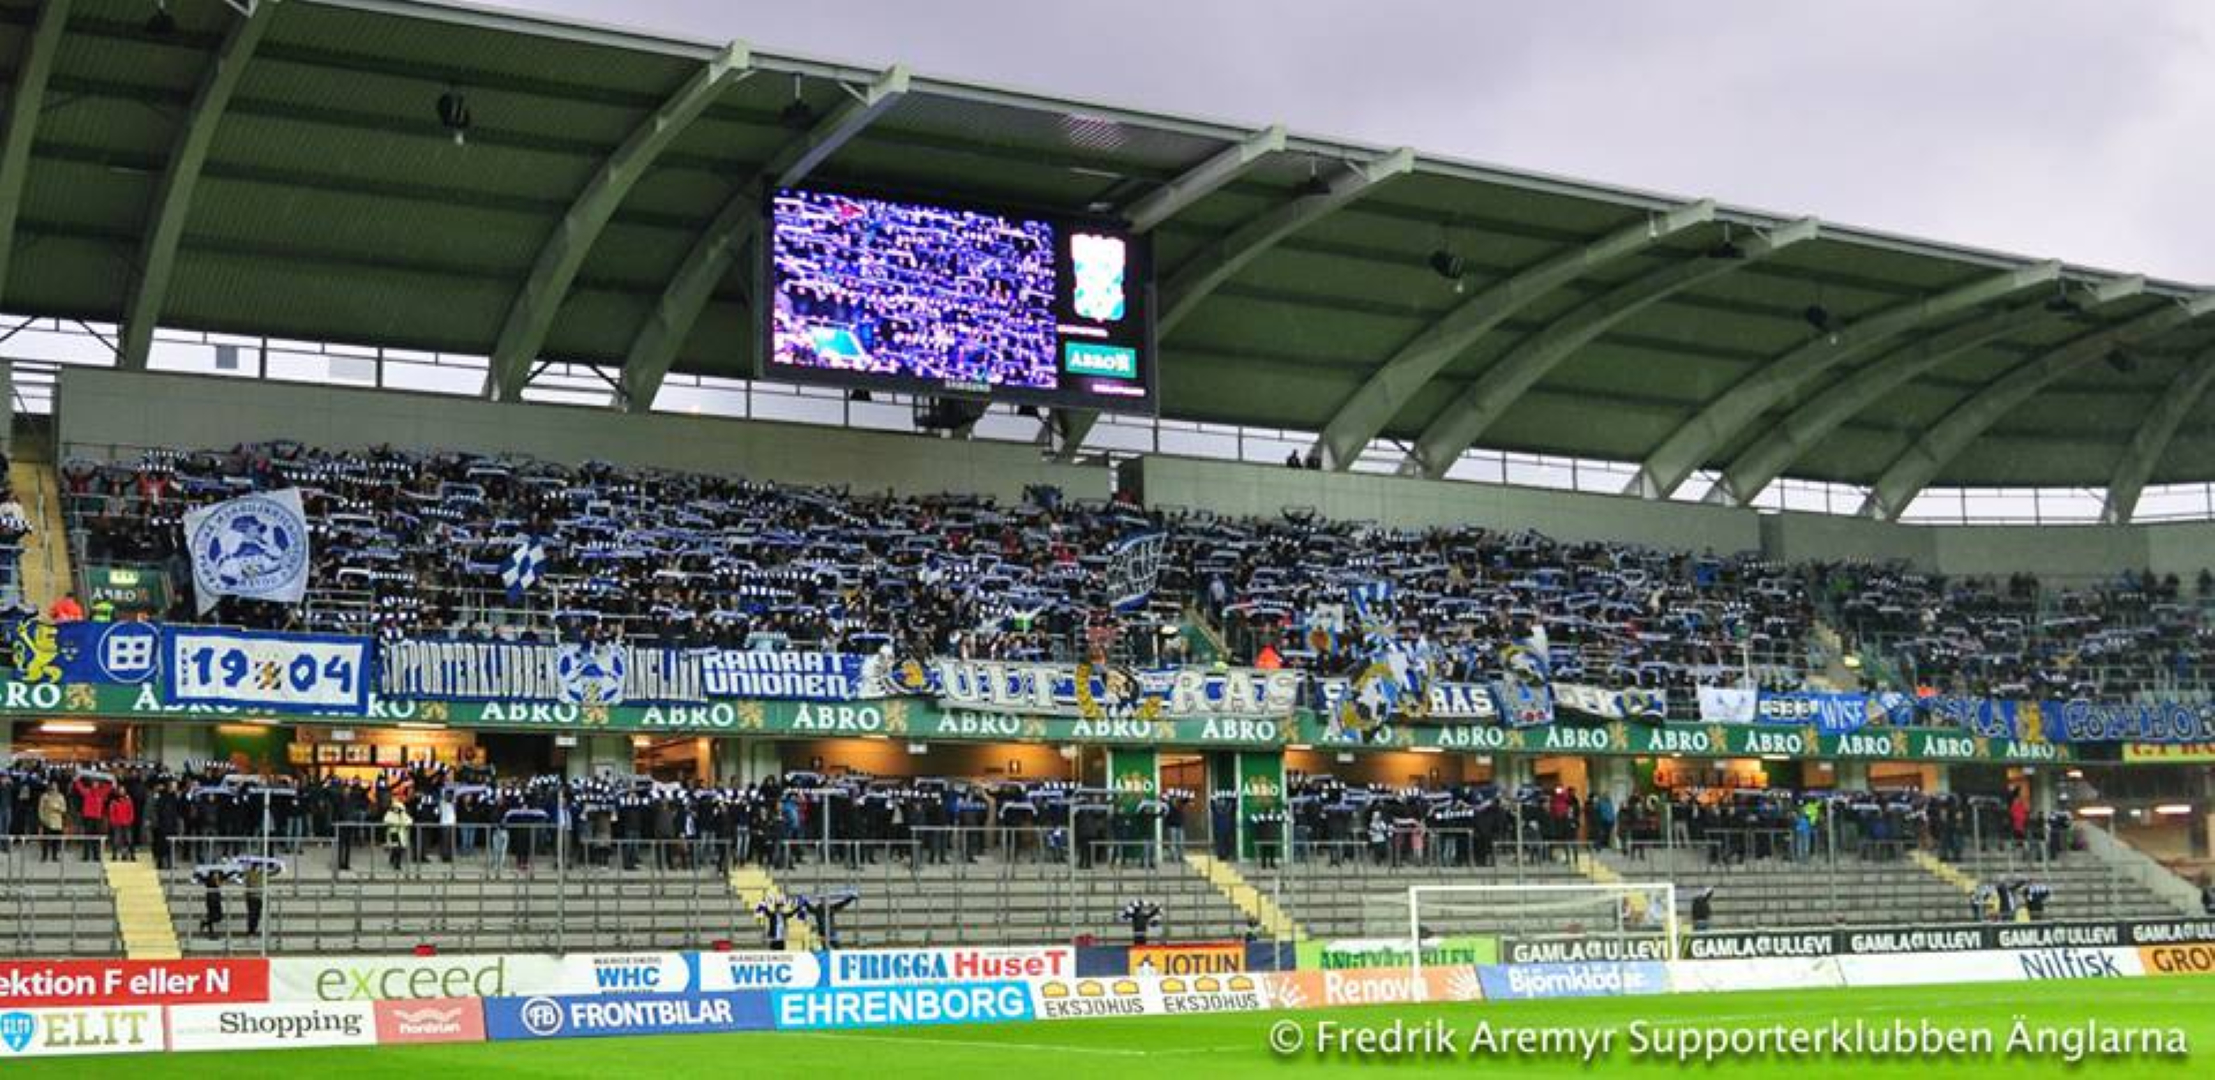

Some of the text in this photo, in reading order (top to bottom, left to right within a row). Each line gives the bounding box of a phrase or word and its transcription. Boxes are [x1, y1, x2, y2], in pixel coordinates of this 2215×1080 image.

[0, 681, 62, 708] RO
[1691, 935, 1832, 958] GAMLA ULLEVI
[1851, 930, 1982, 952] GAMLA ULLEVI
[1999, 926, 2119, 946] GAMLA ULLEVI
[2133, 924, 2183, 942] GAMLA
[1514, 942, 1586, 962] GAMLA
[2019, 947, 2123, 979] Nilfisk
[596, 966, 661, 988] WHC
[730, 963, 793, 984] WHC
[840, 953, 948, 981] FRIGGA
[0, 968, 230, 996] ektion F eller N
[571, 999, 733, 1028] FRONTBILAR
[781, 987, 1025, 1025] EHRENBORG
[43, 1012, 147, 1047] ELIT
[219, 1011, 362, 1039] Shopping
